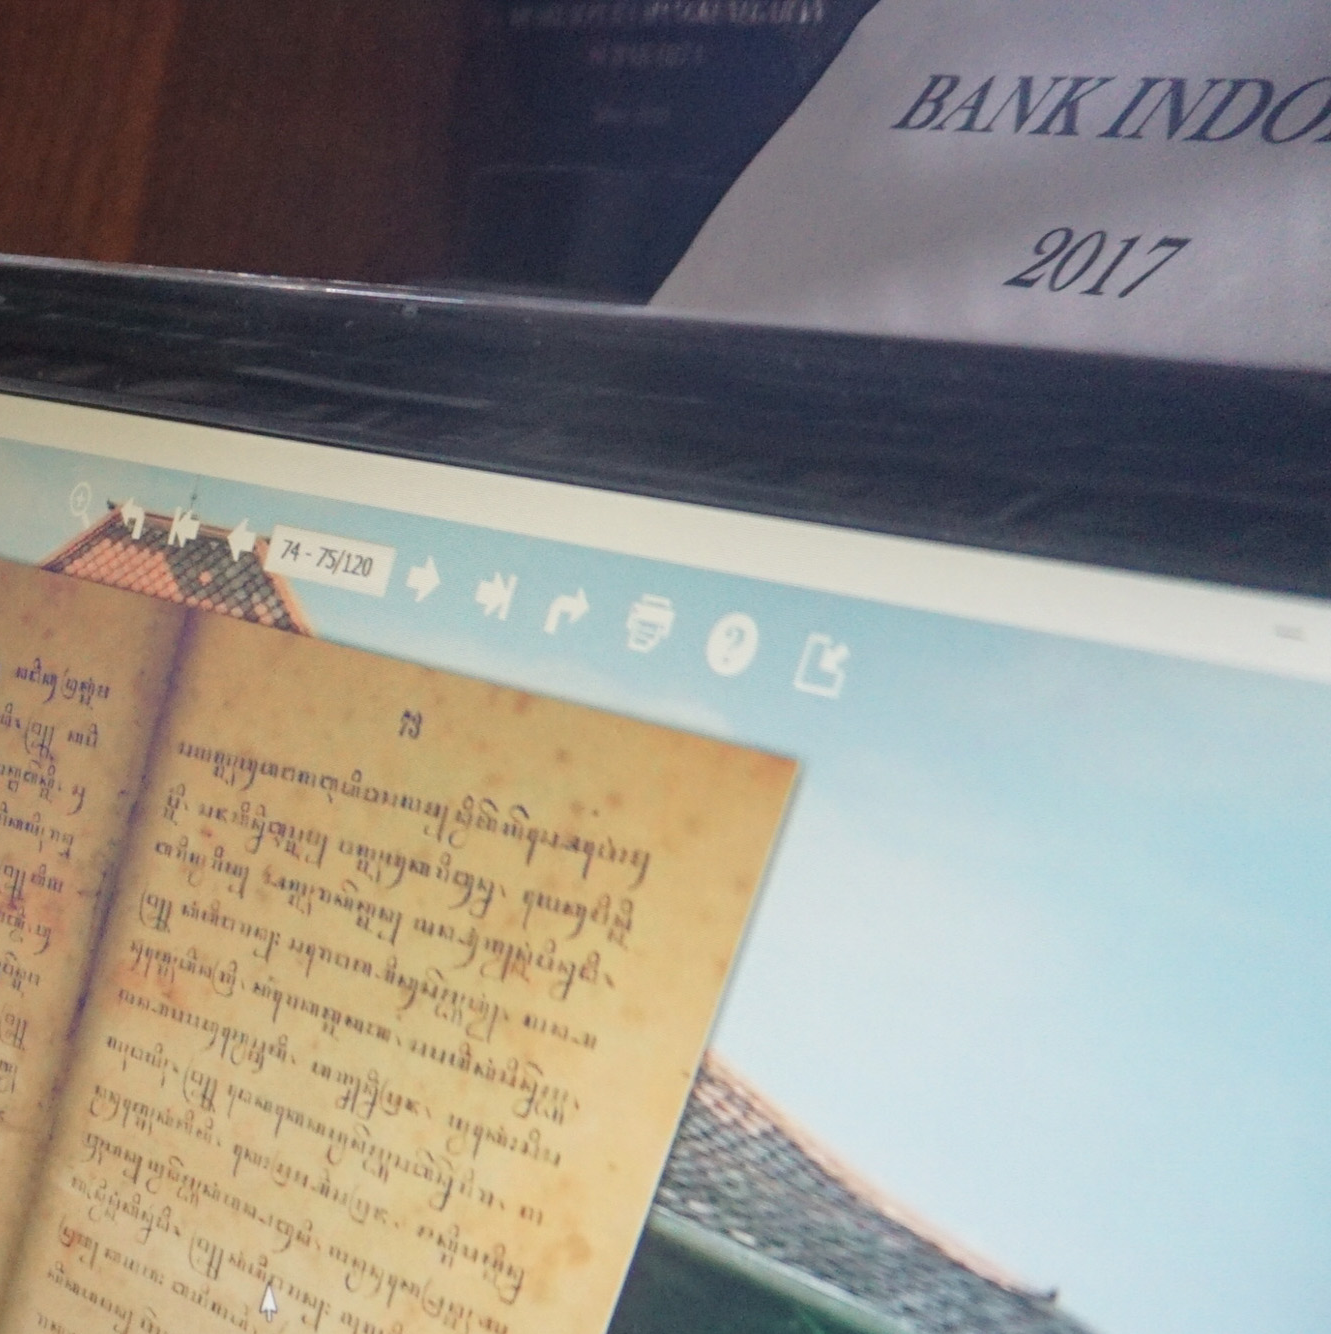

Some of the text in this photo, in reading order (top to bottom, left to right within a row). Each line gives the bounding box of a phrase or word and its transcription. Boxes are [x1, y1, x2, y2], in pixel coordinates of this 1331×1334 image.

[890, 73, 1331, 144] BANK INDO
[1002, 226, 1193, 298] 2017
[281, 539, 302, 561] 74
[316, 547, 374, 578] 75/120
